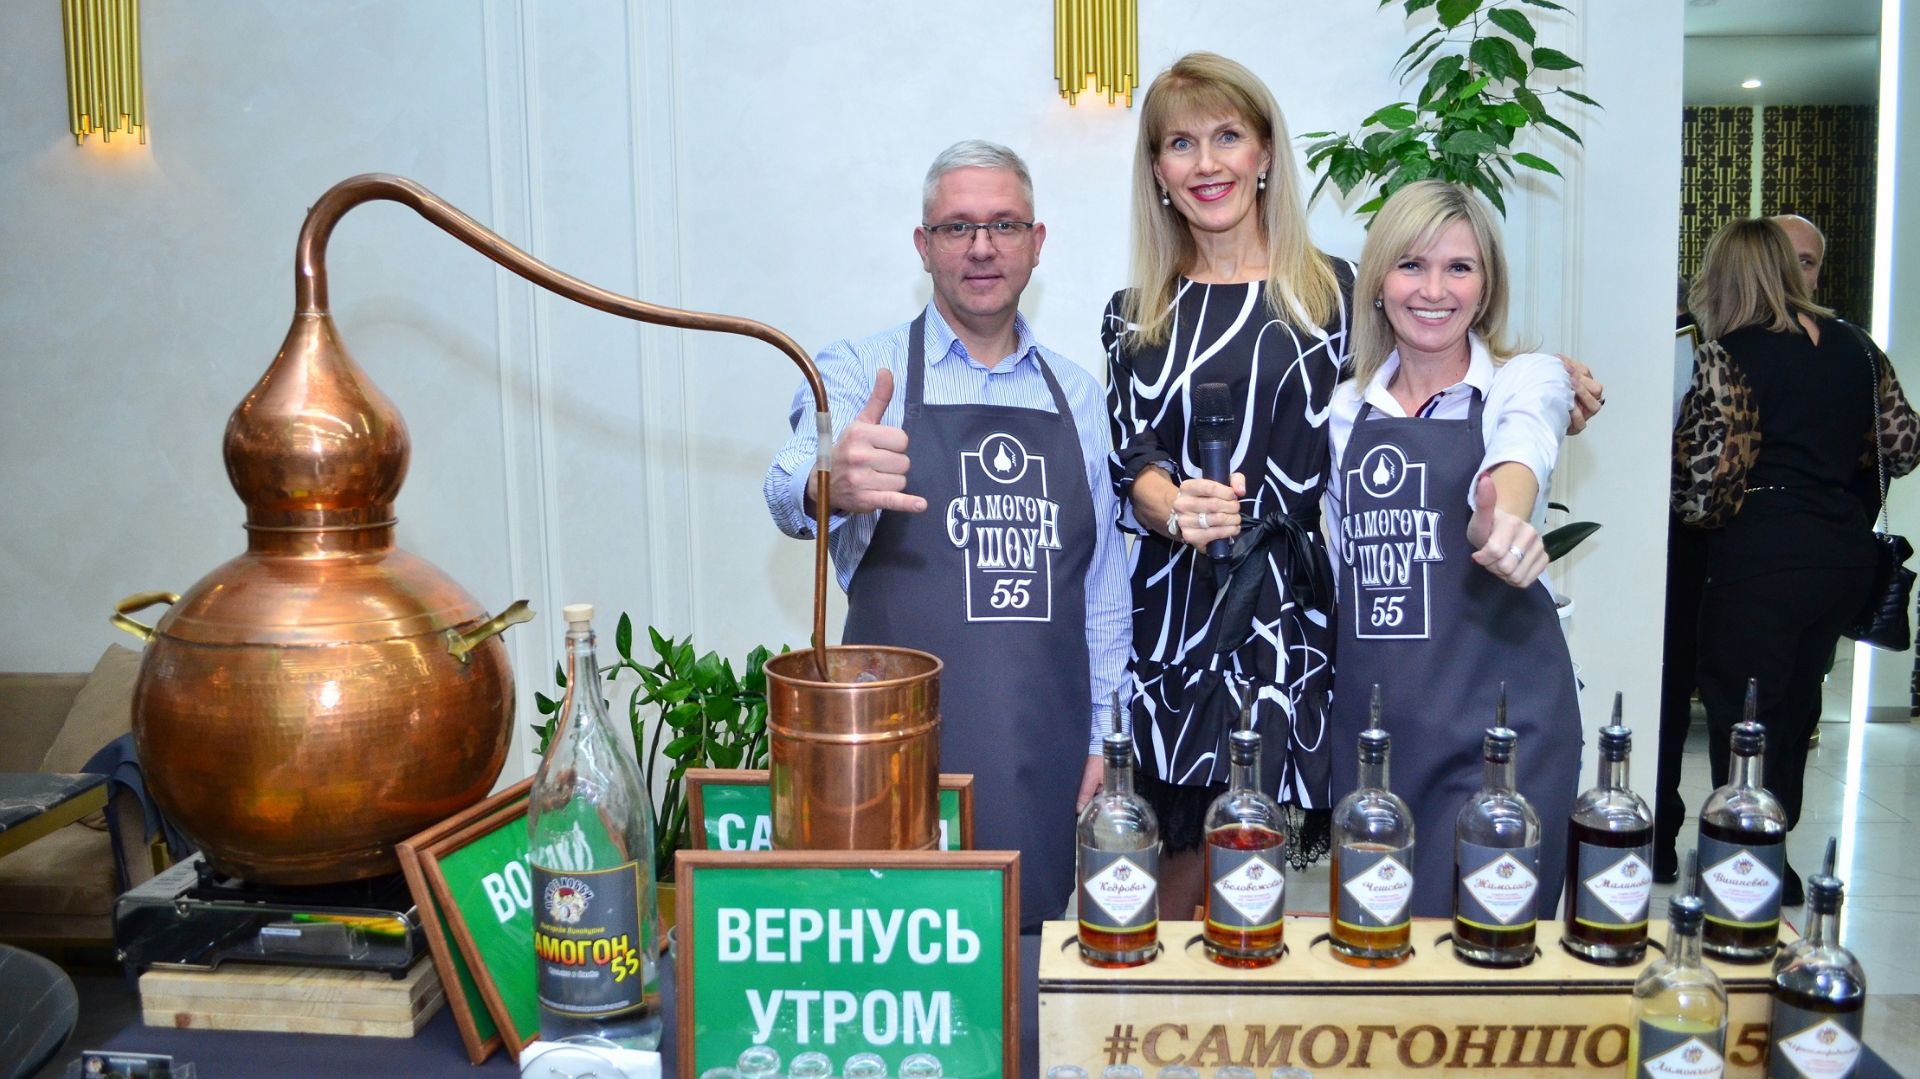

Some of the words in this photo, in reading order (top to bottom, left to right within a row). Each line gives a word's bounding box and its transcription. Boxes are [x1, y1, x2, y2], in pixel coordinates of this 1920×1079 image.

[946, 495, 1062, 549] САМОГОН
[1341, 509, 1444, 566] САМОГОН
[976, 527, 1039, 569] ШОУ
[1358, 542, 1415, 586] ШОУ
[990, 578, 1032, 609] 55
[1371, 595, 1406, 627] 55
[717, 908, 981, 965] ВЕРНУСЬ
[611, 948, 640, 983] 55
[745, 990, 952, 1046] УТРОМ
